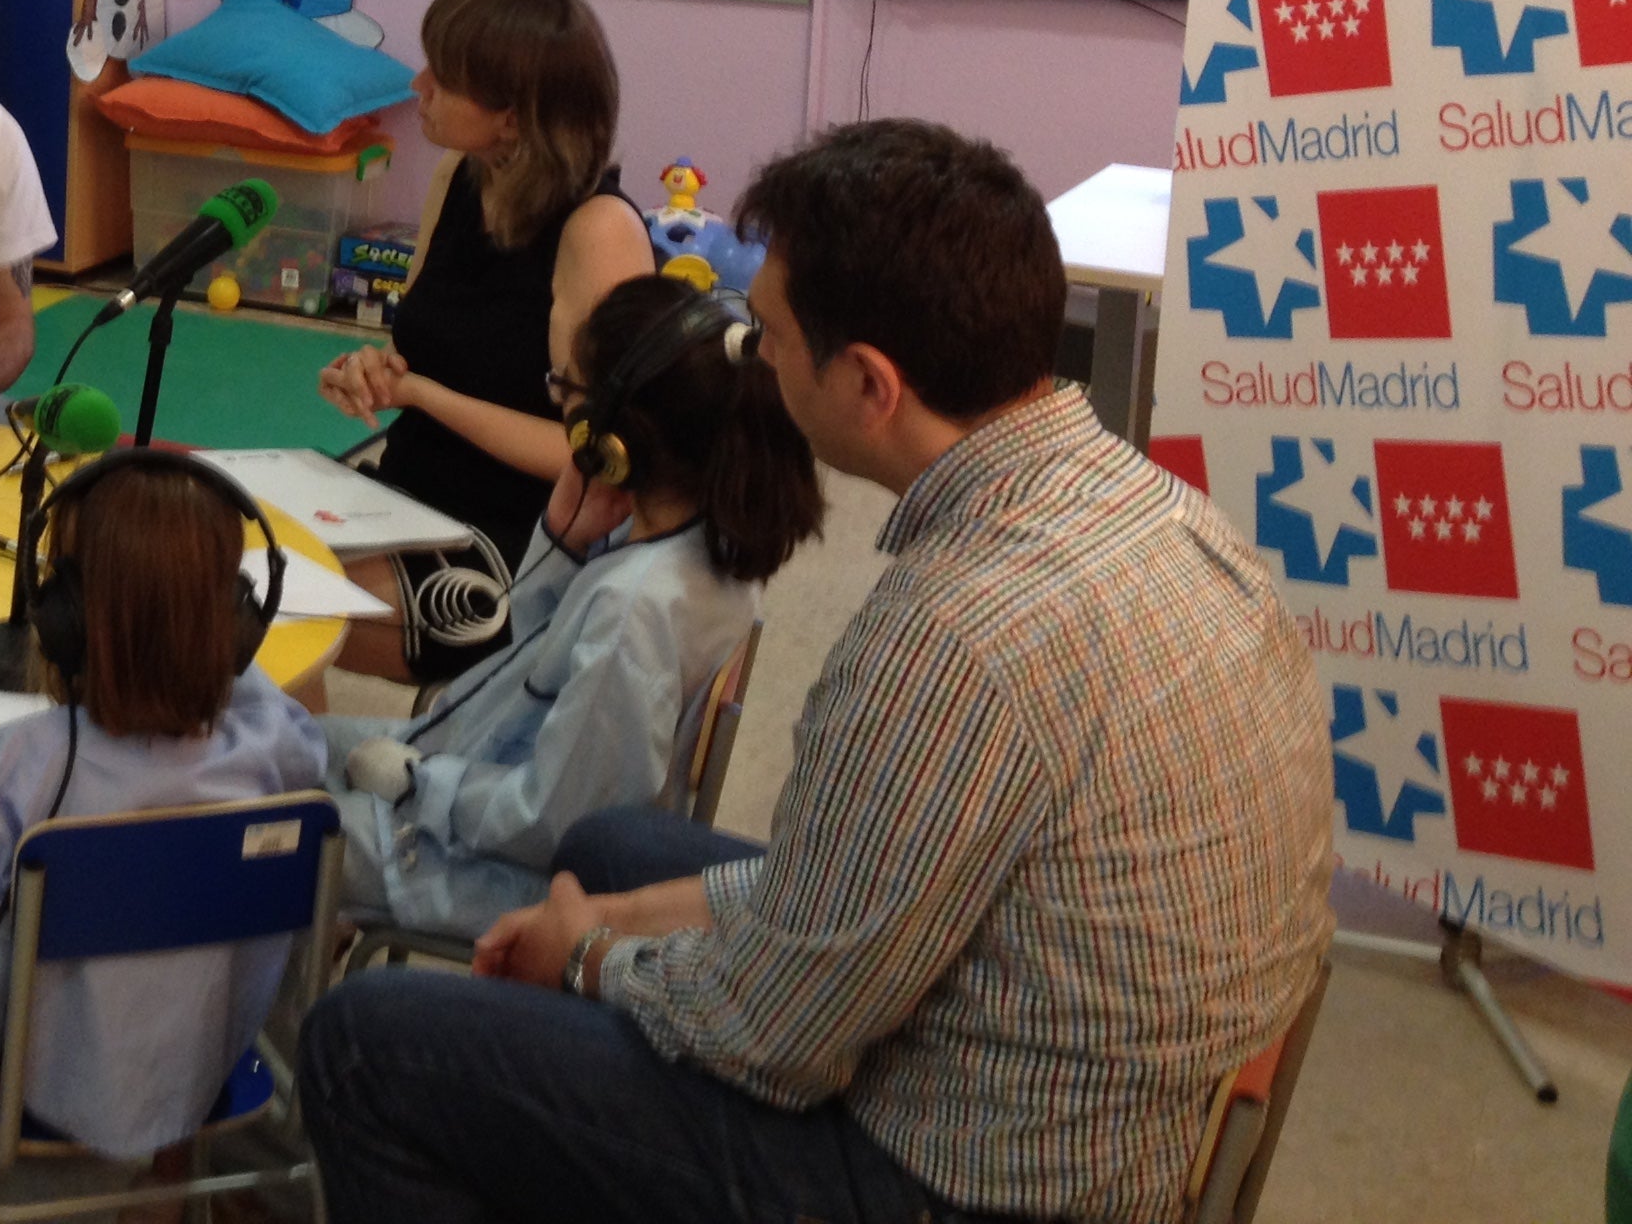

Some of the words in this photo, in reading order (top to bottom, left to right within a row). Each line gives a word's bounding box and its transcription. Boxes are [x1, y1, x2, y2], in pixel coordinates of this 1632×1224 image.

[1200, 360, 1461, 412] SaludMadrid
[1501, 360, 1632, 414] Salud
[1572, 627, 1632, 681] Sa
